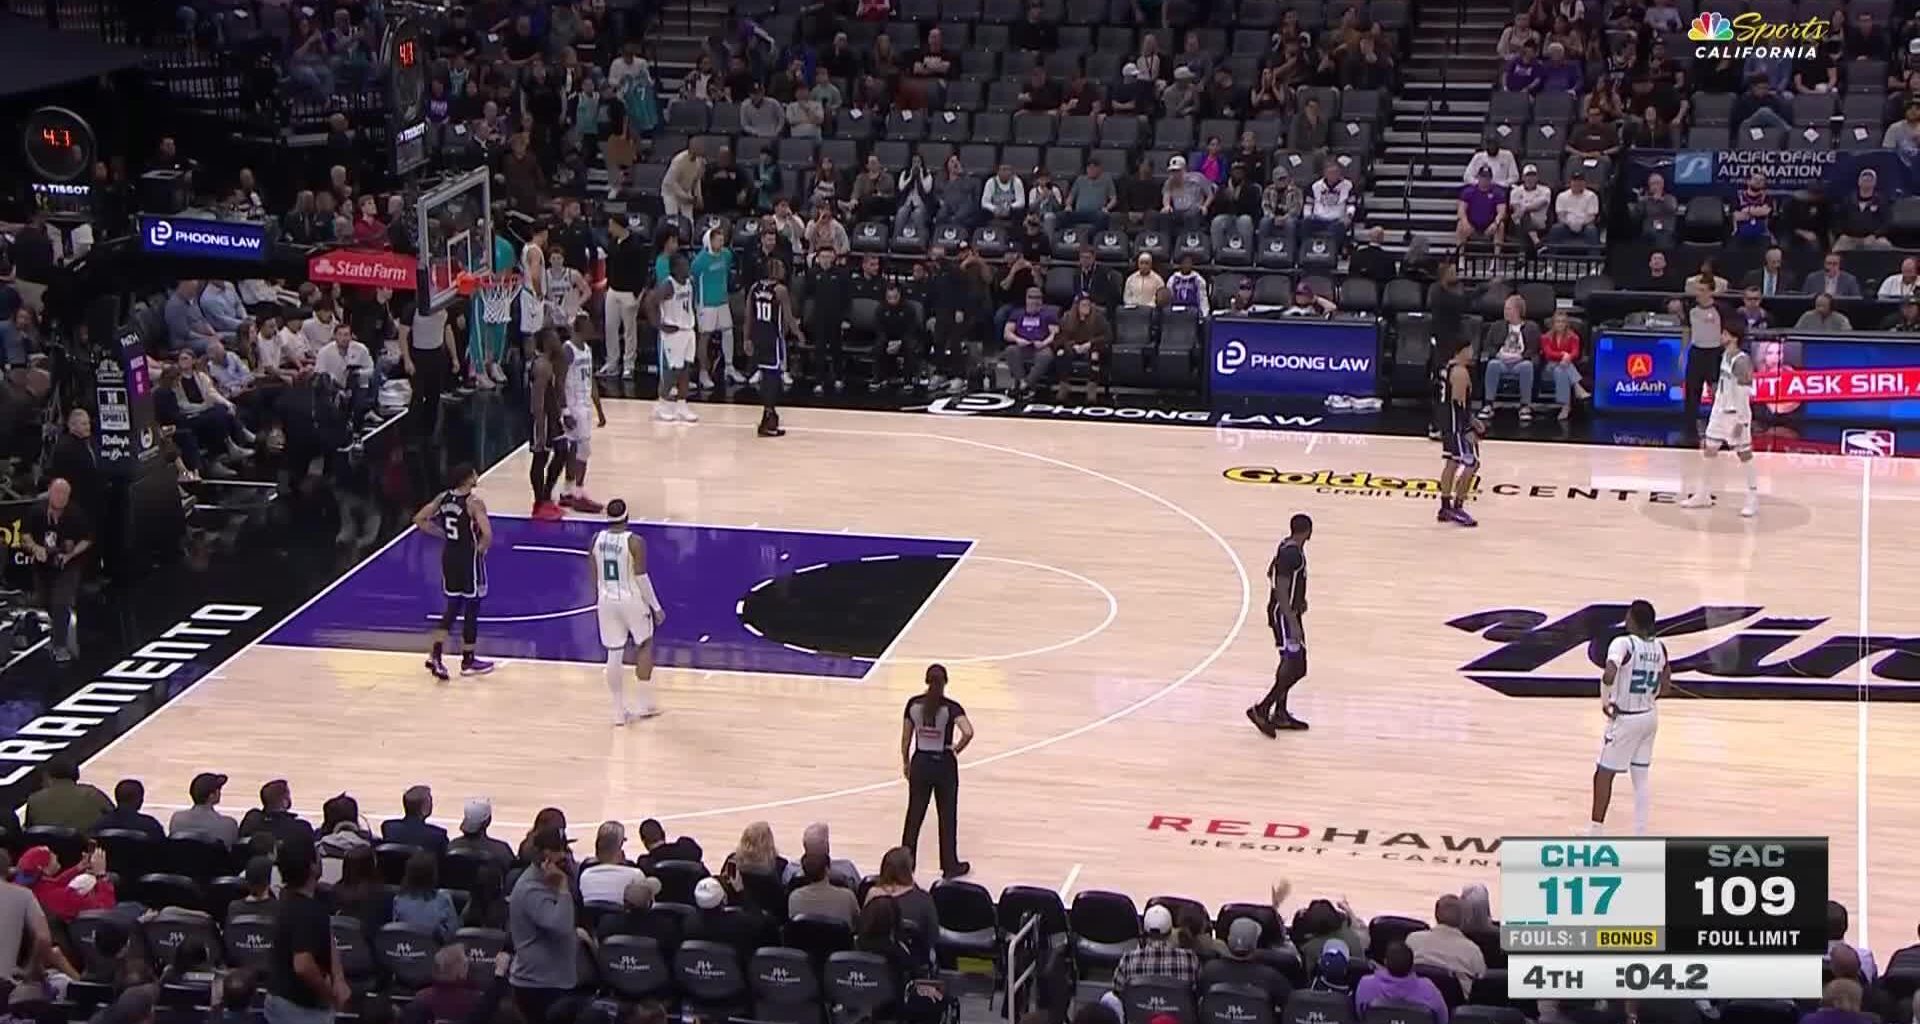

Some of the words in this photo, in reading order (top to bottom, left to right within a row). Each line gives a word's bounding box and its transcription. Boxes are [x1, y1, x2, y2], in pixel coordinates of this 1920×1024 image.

[1718, 152, 1776, 164] PACIFIC
[1780, 151, 1837, 163] OFFICE
[1718, 165, 1822, 177] AUTOMATION
[47, 184, 91, 195] TISSOT
[175, 231, 230, 247] PHOONG
[231, 237, 261, 249] LAW
[756, 301, 773, 321] 10
[1251, 354, 1325, 369] PHOONG
[1329, 358, 1369, 371] LAW
[1615, 381, 1666, 393] AskAnh
[1788, 375, 1842, 395] ASK
[1851, 373, 1910, 396] SIRI,
[1023, 403, 1210, 422] PHOONG
[1221, 413, 1325, 427] LAW
[1223, 467, 1441, 492] Golden
[1492, 484, 1717, 506] CENTE
[445, 516, 458, 540] 5
[603, 560, 619, 581] 0
[1629, 669, 1661, 694] 24
[0, 604, 263, 786] RAMENTO
[1147, 815, 1502, 854] REDHAW
[1190, 839, 1329, 855] RESORT
[1381, 853, 1501, 868] CASIN
